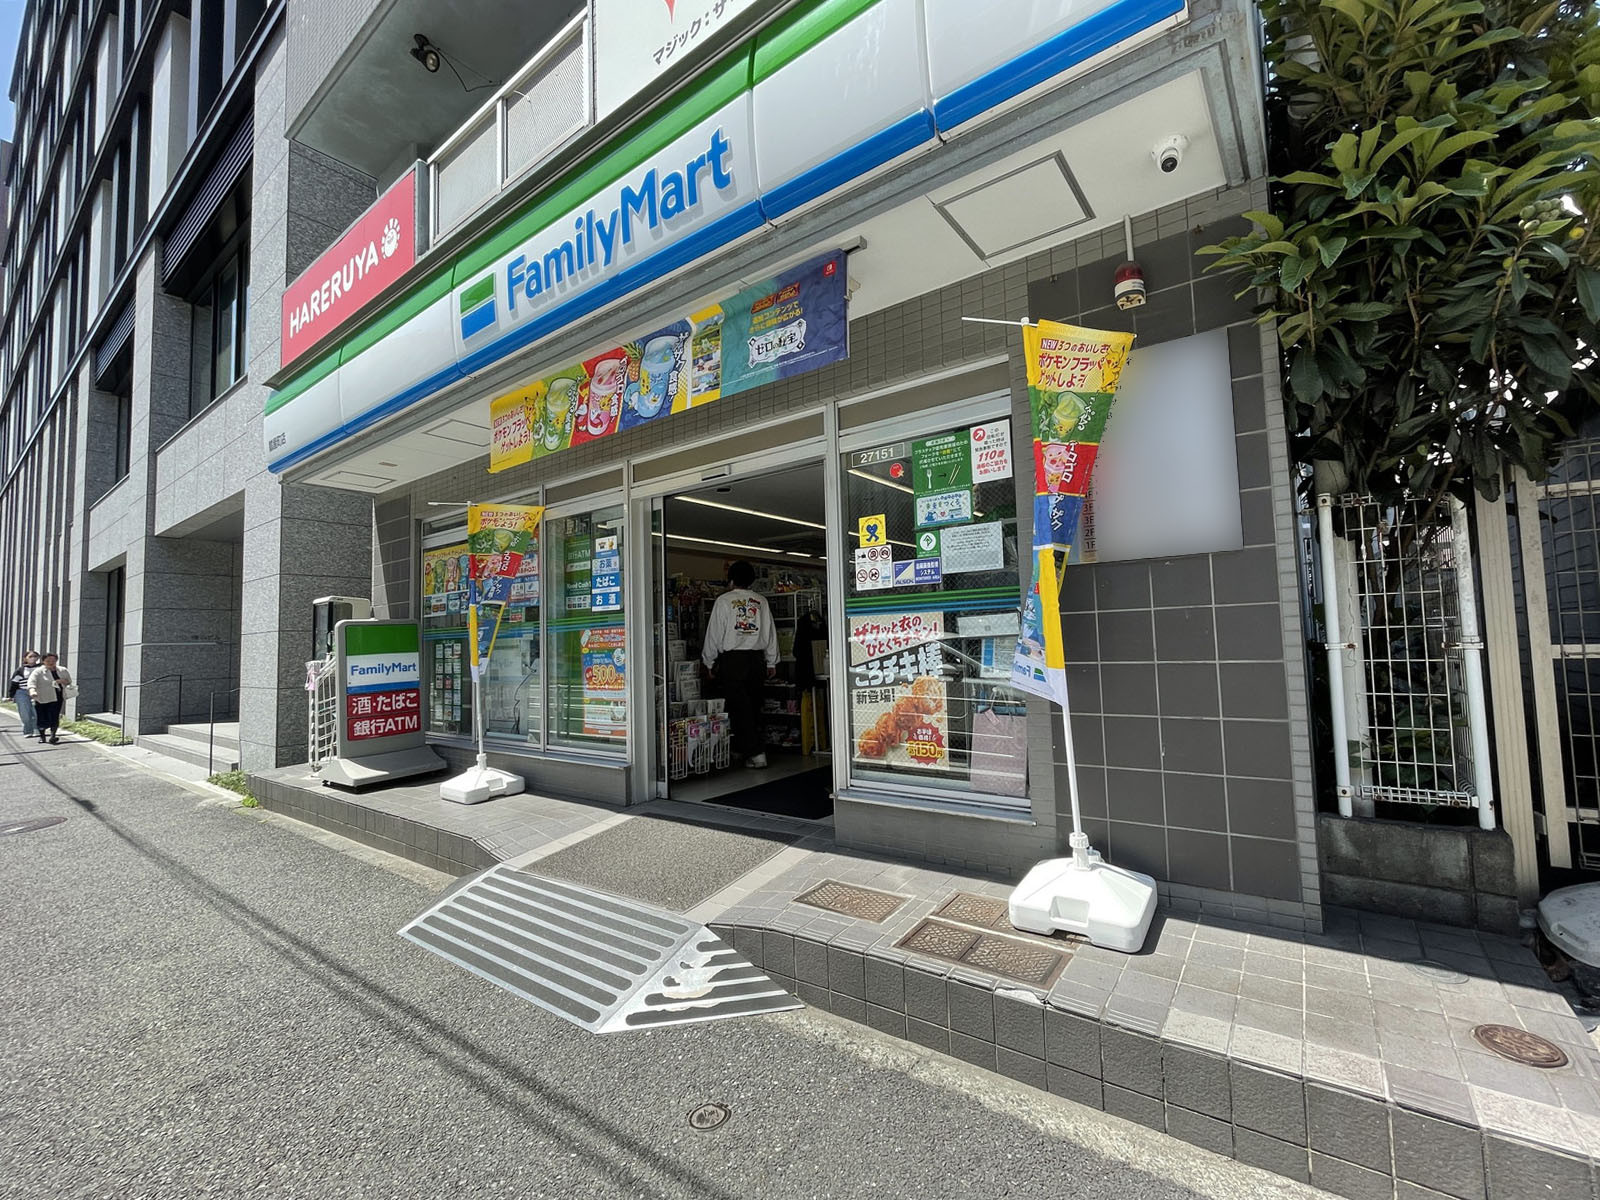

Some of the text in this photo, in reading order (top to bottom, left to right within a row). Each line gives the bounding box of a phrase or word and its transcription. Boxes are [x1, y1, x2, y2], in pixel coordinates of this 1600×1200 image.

[507, 127, 731, 312] FamilyMart
[289, 240, 379, 339] HARERUYA
[1042, 339, 1111, 354] NEW 3つのおいしさ
[860, 447, 894, 464] 27151
[1083, 503, 1094, 512] 3F
[1084, 516, 1095, 525] 3F
[1085, 528, 1095, 537] 2F
[1086, 541, 1096, 549] 1F
[596, 576, 616, 587] たばこ
[351, 662, 416, 676] FamilyMart
[855, 641, 944, 687] ころチキ棒
[352, 693, 417, 714] 酒・たばこ
[856, 688, 895, 704] 新登場!
[353, 715, 417, 736] 銀行ATM
